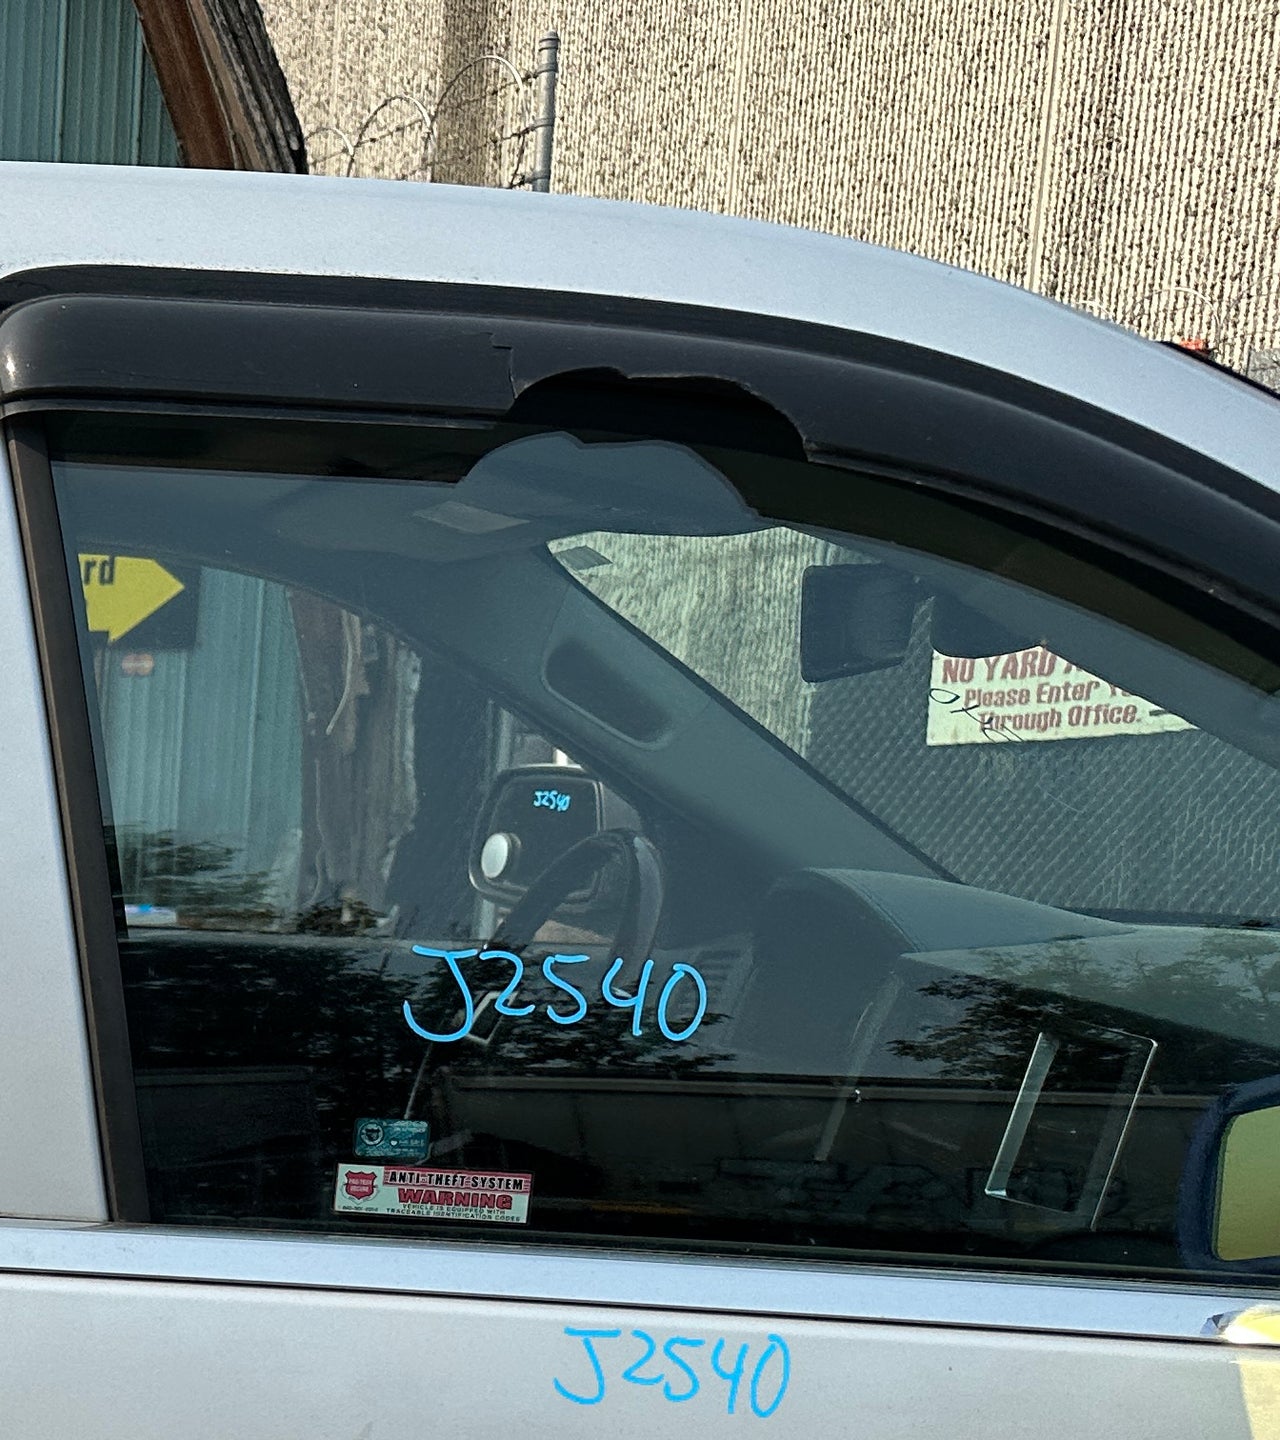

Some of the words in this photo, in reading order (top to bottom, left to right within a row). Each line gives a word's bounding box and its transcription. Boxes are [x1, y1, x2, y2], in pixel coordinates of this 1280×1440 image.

[982, 649, 1058, 682] YARD
[963, 688, 1030, 707] Please
[1035, 680, 1100, 704] Enter
[978, 706, 1062, 733] Through
[1068, 704, 1142, 728] Office.
[402, 943, 708, 1043] J2540
[470, 1177, 524, 1191] SYSTEM
[397, 1188, 514, 1211] WARNING
[552, 1325, 792, 1419] J2540
